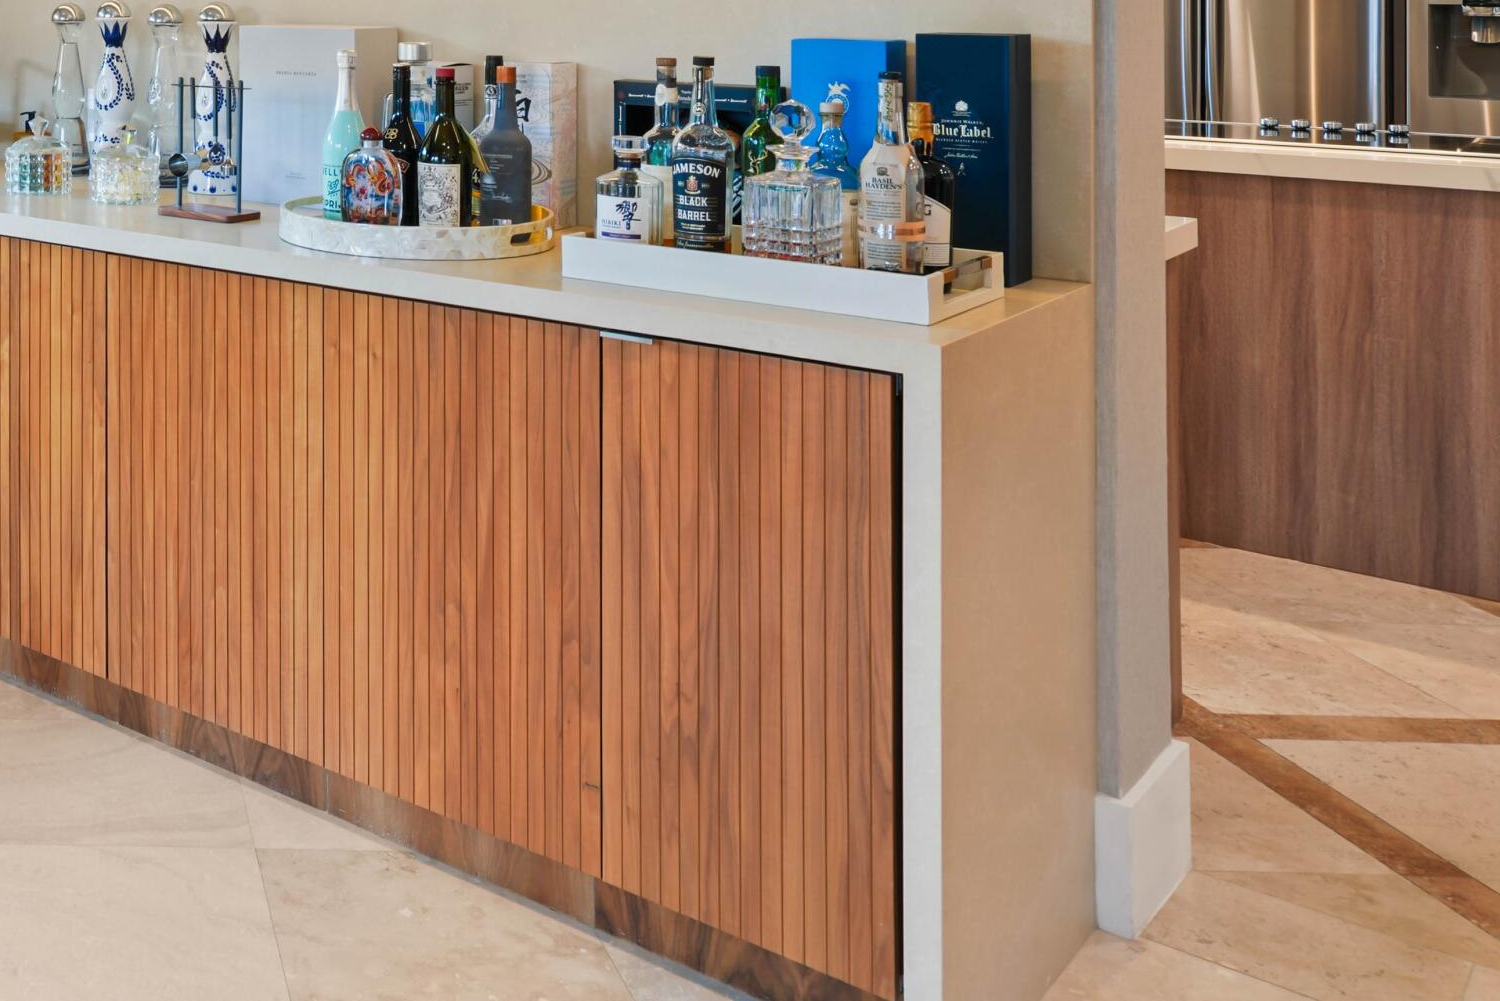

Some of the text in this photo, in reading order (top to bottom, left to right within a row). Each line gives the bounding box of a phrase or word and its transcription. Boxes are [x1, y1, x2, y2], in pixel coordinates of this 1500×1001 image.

[932, 122, 991, 138] Blue Label
[672, 162, 721, 179] JAMESON
[679, 194, 709, 207] BLACK
[677, 208, 712, 222] BARREL
